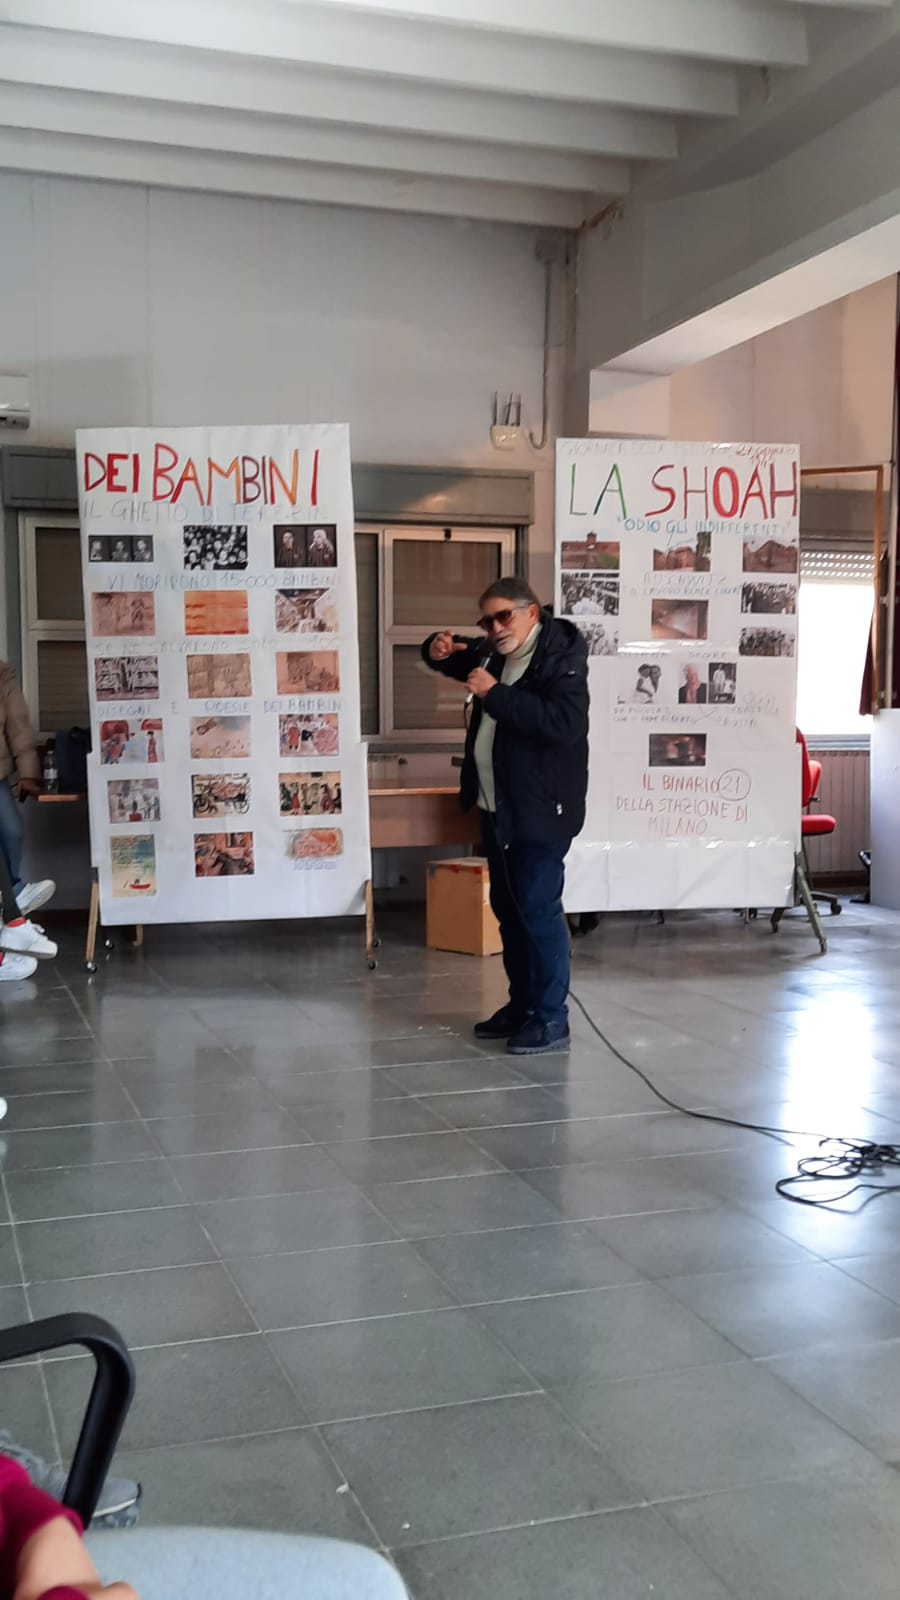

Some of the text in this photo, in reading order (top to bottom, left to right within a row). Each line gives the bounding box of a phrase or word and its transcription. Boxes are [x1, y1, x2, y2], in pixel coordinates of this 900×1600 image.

[84, 442, 320, 506] DEI BAMBINI
[569, 461, 798, 520] LA SHOAH
[112, 499, 188, 523] GHETTO
[666, 518, 688, 535] GLI
[642, 773, 741, 795] IL BINARIO 21
[615, 795, 748, 822] DELLA STAZIONE DI
[649, 816, 708, 837] MILANO
